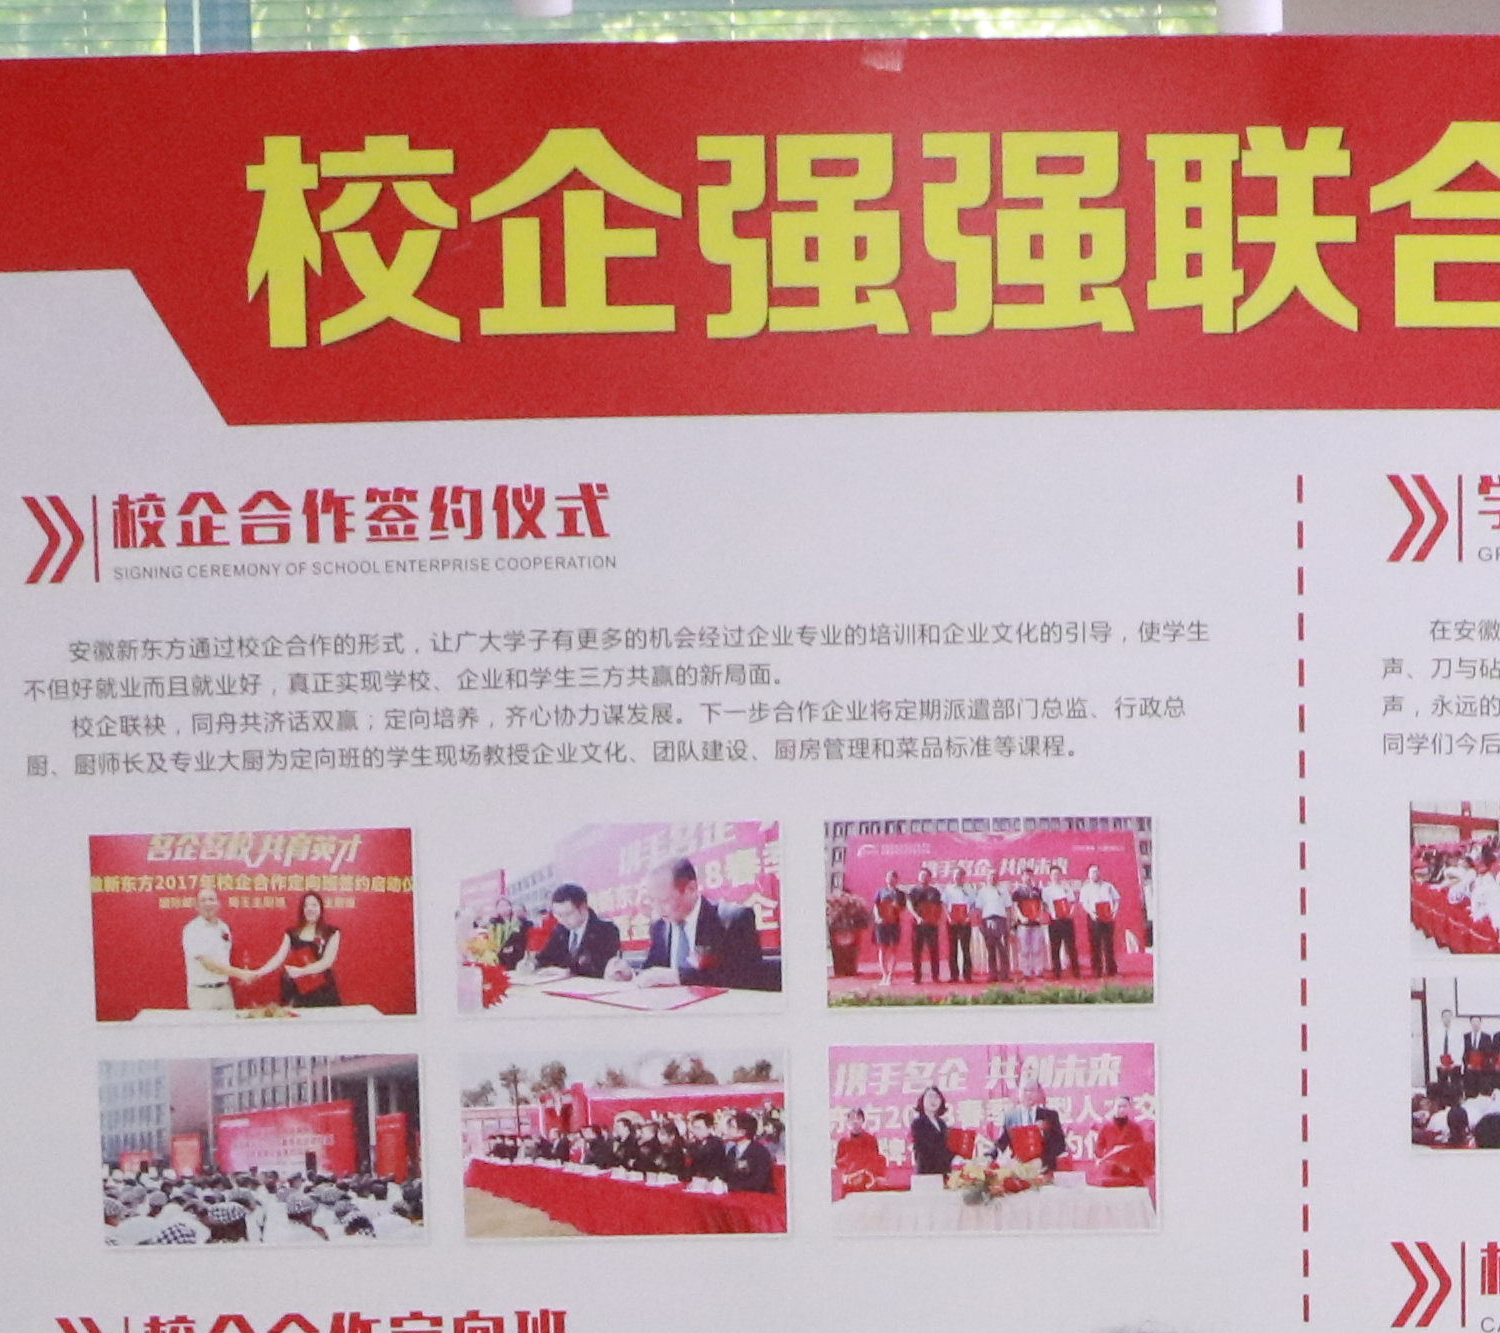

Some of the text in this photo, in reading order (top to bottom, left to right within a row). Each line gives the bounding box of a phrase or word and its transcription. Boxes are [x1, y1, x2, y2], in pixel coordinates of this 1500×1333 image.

[113, 483, 609, 548] 校企合作签约仪式
[114, 555, 616, 580] SIGNING CEREMONY OF SCHOOL ENTERPRISE COOPERATION
